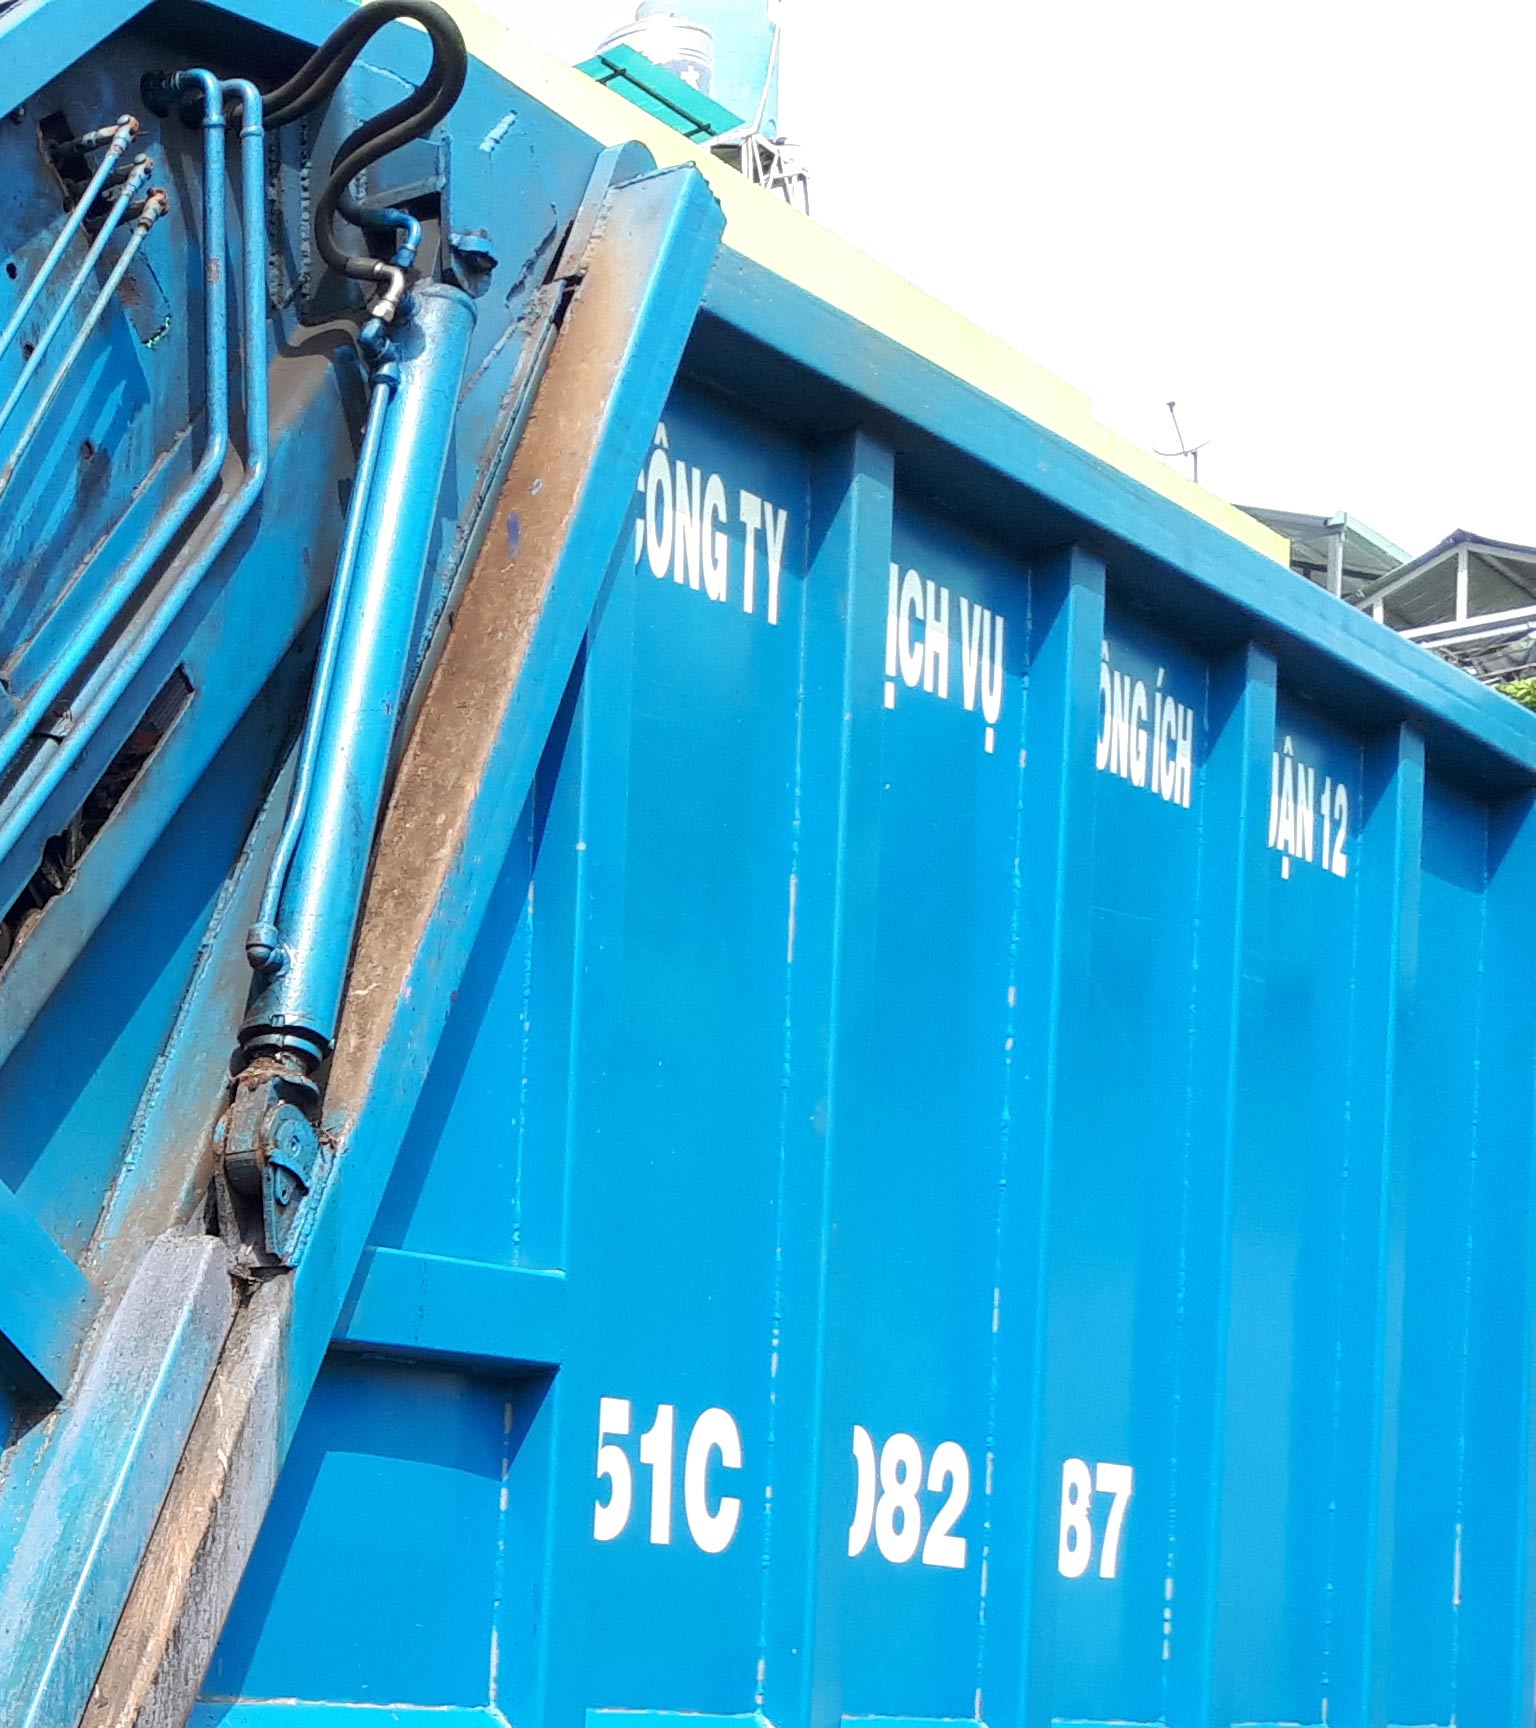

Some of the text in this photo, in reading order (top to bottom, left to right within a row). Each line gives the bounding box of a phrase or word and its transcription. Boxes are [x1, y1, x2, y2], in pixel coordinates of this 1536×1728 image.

[739, 489, 788, 626] TY
[884, 562, 950, 710] ỊCH
[960, 596, 1005, 754] VỤ
[1096, 640, 1148, 788] ÔNG
[1151, 666, 1194, 809] ÍCH
[1321, 775, 1349, 879] 12
[593, 1397, 742, 1554] 51C
